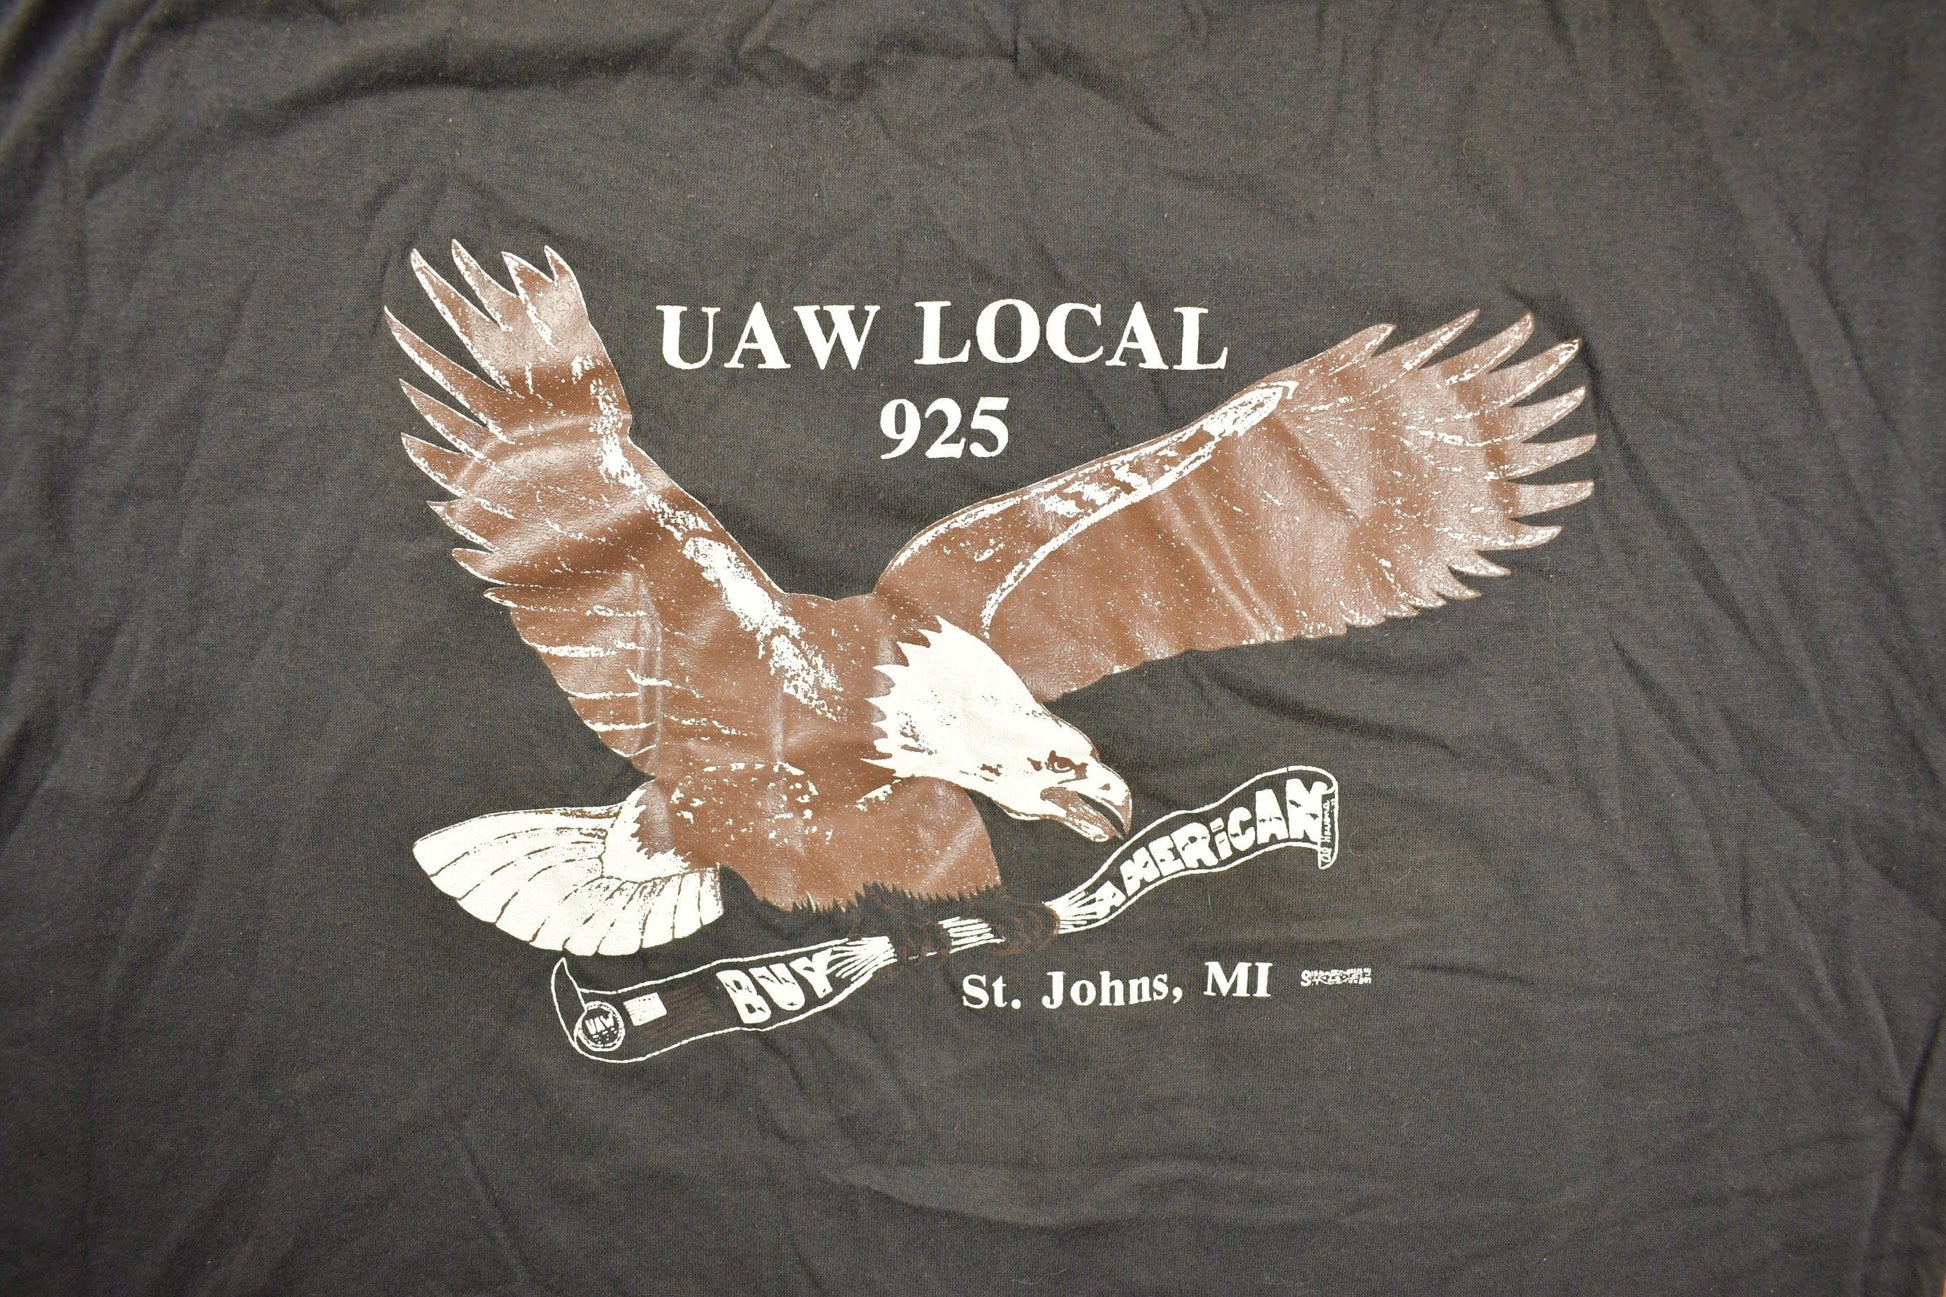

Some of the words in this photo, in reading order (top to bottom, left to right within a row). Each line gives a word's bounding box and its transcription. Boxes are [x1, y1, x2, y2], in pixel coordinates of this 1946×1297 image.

[656, 301, 880, 370] UAW
[914, 299, 1228, 370] LOCAL
[880, 397, 1009, 459] 925
[716, 949, 834, 1024] BUY
[962, 974, 1022, 1010] St.
[1042, 970, 1182, 1008] Johns,
[1203, 962, 1274, 998] MI
[584, 1012, 615, 1035] UAW
